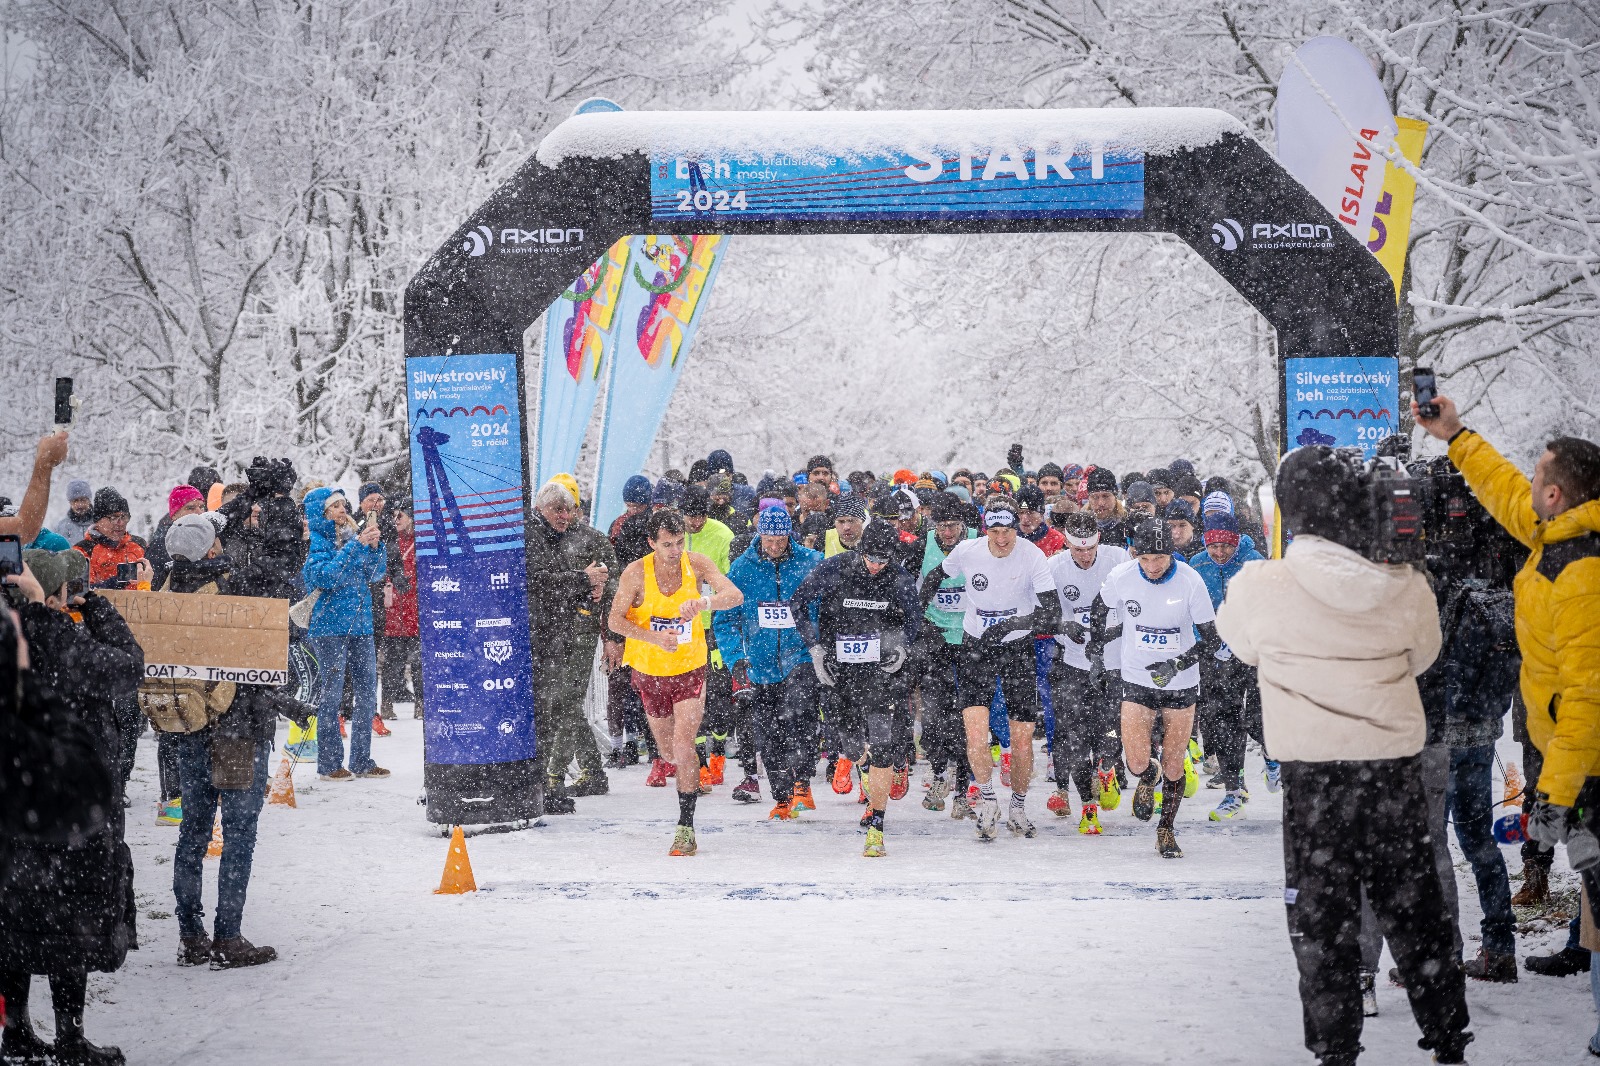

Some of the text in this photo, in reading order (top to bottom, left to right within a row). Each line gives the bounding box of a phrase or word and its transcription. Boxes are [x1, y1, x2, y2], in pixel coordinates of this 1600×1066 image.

[904, 150, 1104, 182] START
[737, 167, 778, 181] mosty
[676, 190, 749, 211] 2024
[500, 228, 584, 244] AXION
[1252, 223, 1332, 239] AXION
[500, 245, 582, 254] axion4event.com
[1252, 240, 1334, 249] axion4event.com
[1296, 371, 1392, 387] Silvestrovský
[414, 386, 437, 400] beh
[1296, 388, 1324, 401] beh
[470, 422, 509, 437] 2024
[471, 438, 485, 447] 33.
[936, 593, 962, 605] 589
[764, 608, 788, 620] 555
[1141, 634, 1168, 645] 478
[843, 641, 869, 654] 587
[142, 664, 177, 677] OAT
[482, 678, 515, 691] OLO
